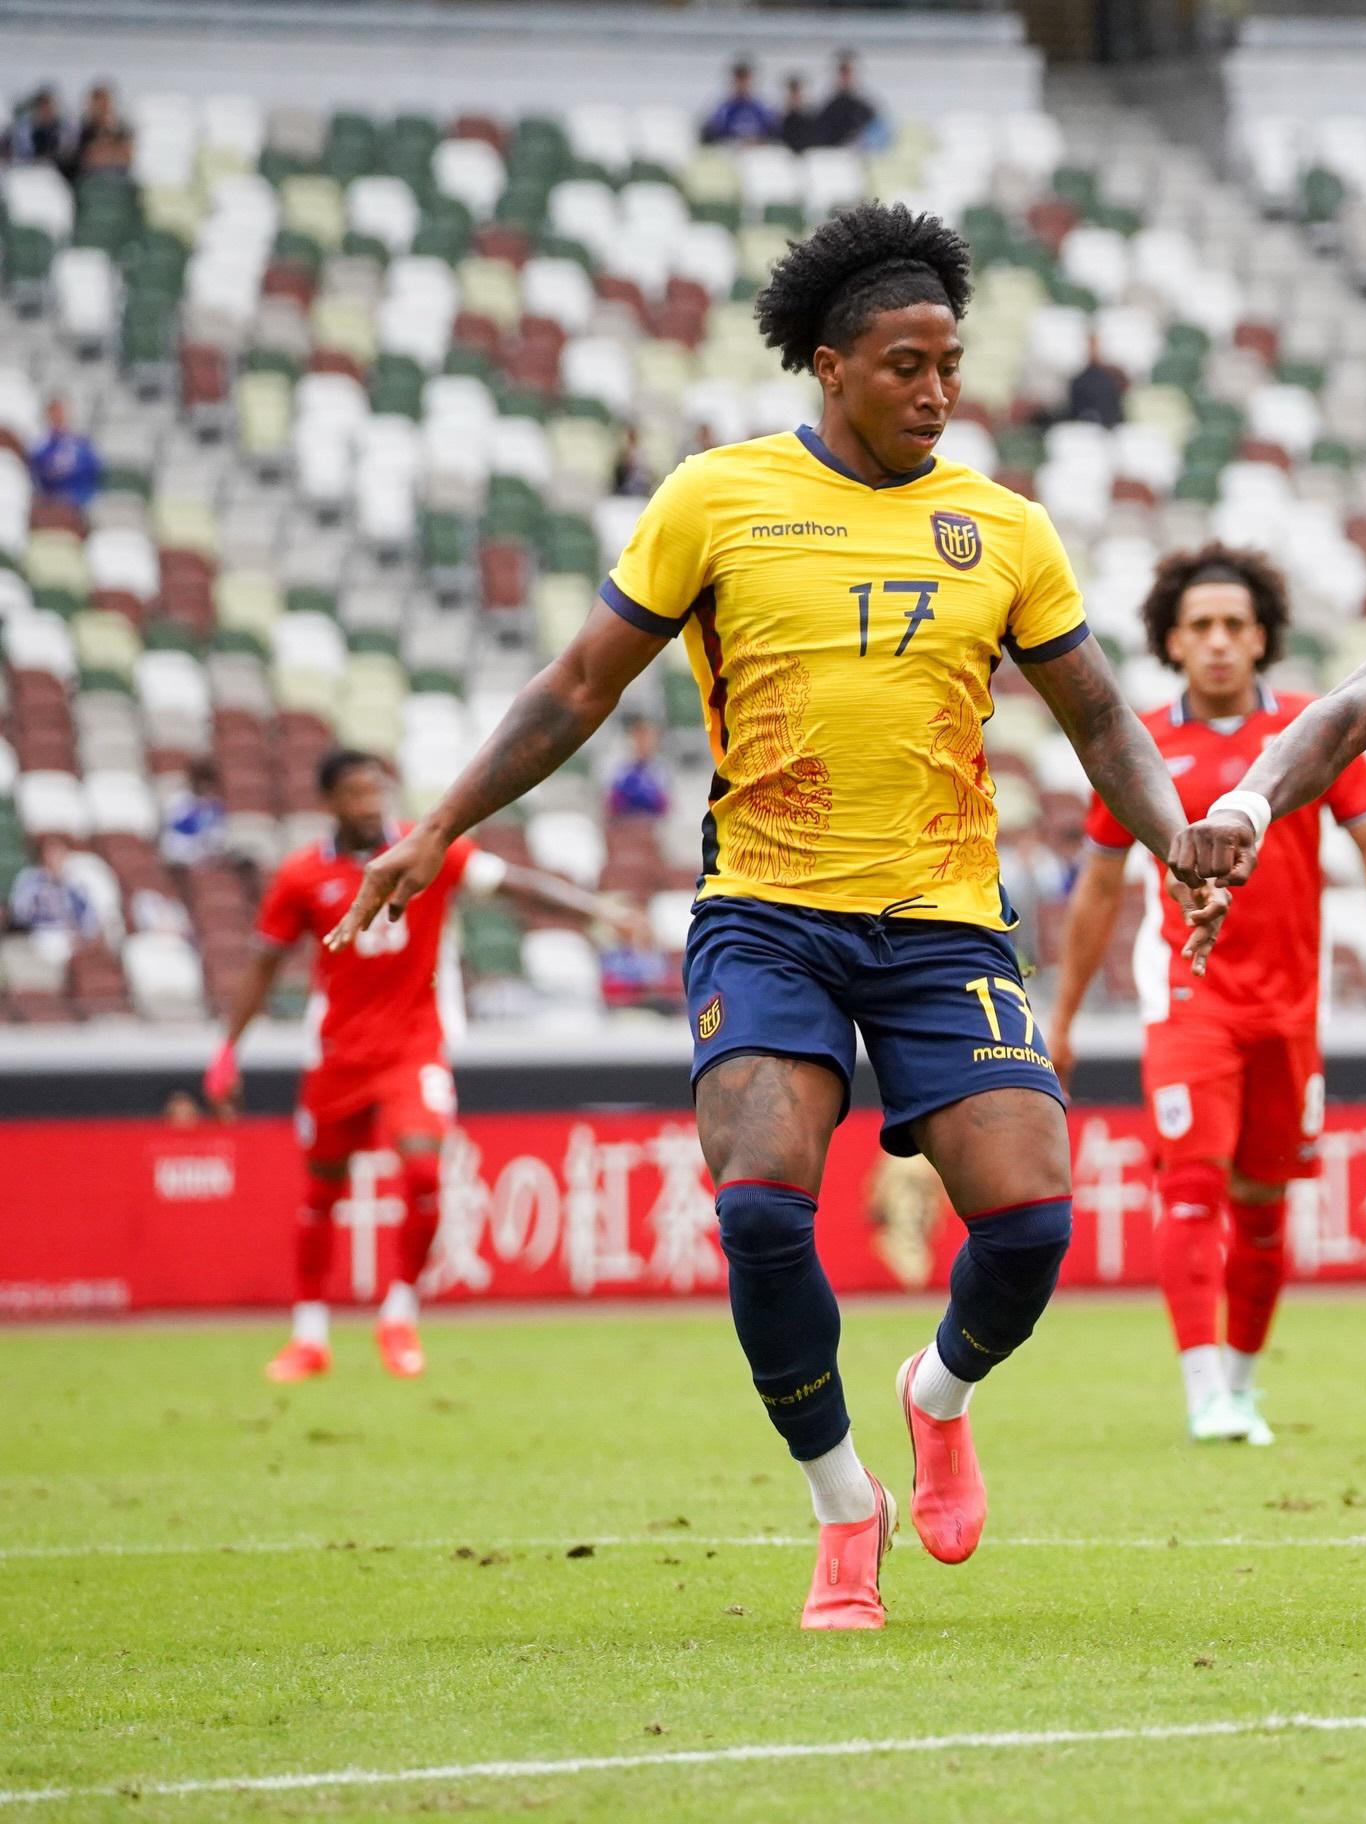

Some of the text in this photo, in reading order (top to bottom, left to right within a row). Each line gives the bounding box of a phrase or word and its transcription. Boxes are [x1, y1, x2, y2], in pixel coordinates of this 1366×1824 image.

[751, 520, 848, 538] marathon
[849, 580, 940, 657] 17
[965, 976, 1034, 1046] 17
[973, 1046, 1056, 1073] marathon
